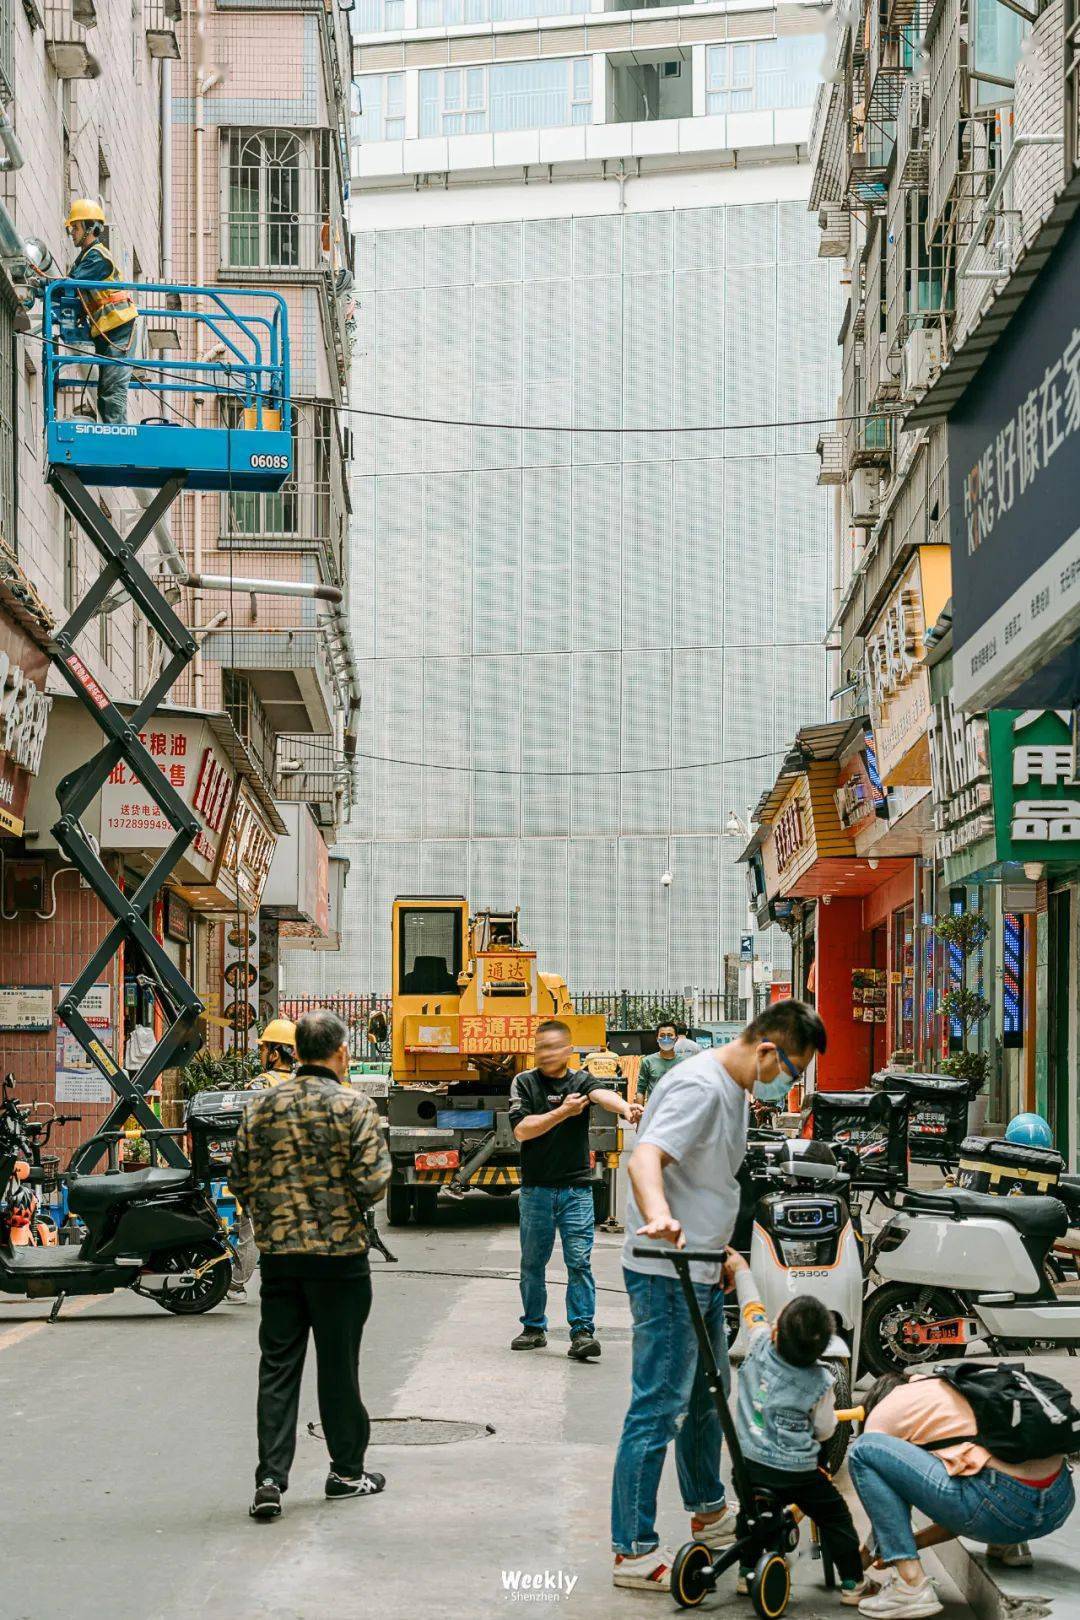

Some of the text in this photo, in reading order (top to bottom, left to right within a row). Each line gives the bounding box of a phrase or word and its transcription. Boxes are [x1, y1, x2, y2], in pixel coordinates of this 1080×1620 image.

[75, 424, 137, 436] SINOBOOM
[996, 328, 1080, 520] 好慷在家
[250, 454, 288, 469] 0608S
[964, 444, 994, 518] HOME
[968, 491, 994, 556] KING
[107, 762, 186, 787] 批售
[121, 804, 160, 816] 送货电话
[487, 961, 526, 981] 通达
